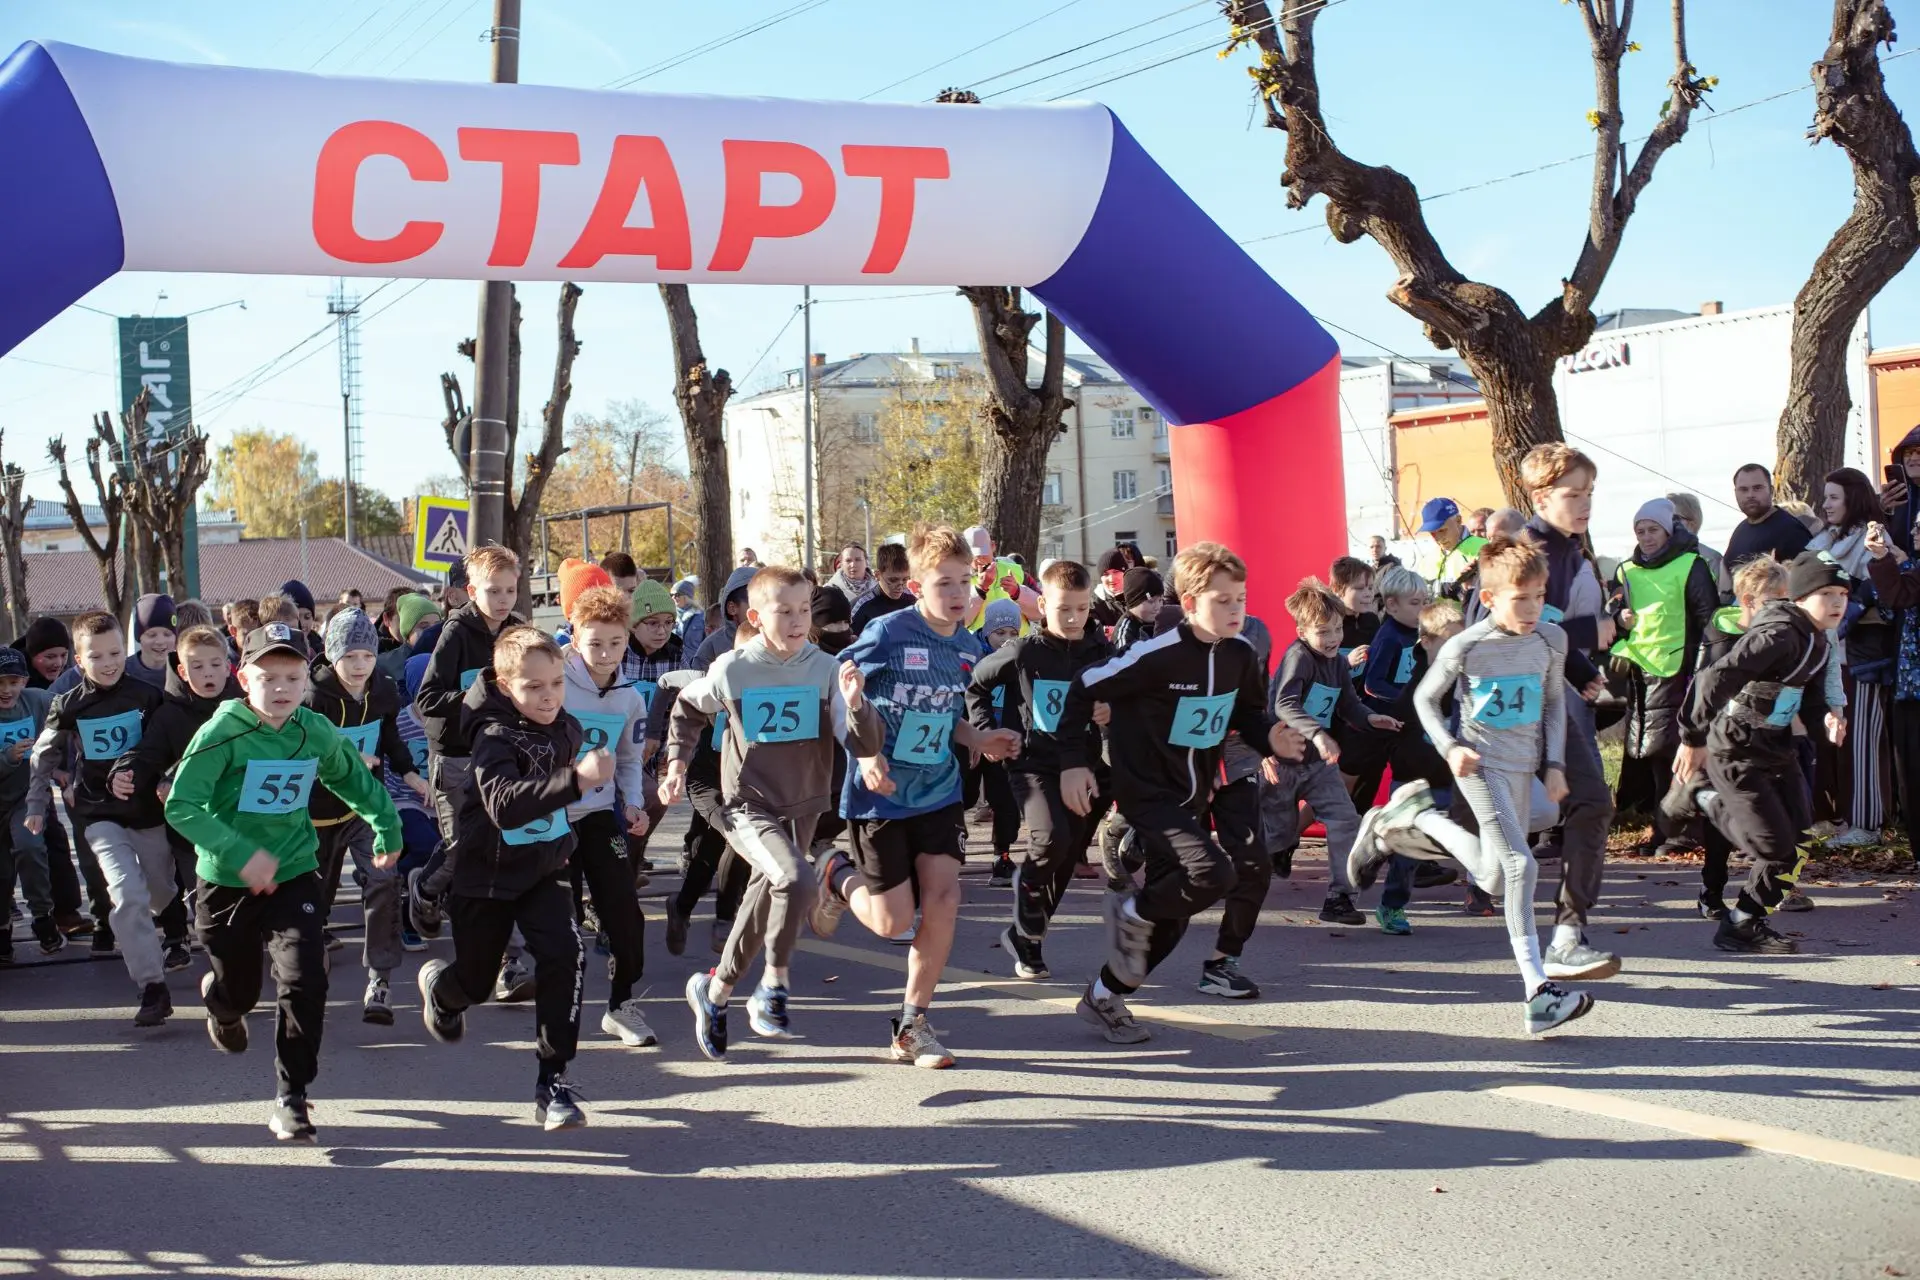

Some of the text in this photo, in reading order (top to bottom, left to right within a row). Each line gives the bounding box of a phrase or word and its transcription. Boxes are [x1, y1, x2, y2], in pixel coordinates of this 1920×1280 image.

[312, 119, 951, 274] СТАРТ
[1168, 683, 1199, 691] KELME
[1486, 686, 1525, 717] 34
[757, 701, 801, 733] 25
[1187, 703, 1230, 736] 26
[93, 725, 128, 753] 59
[910, 724, 945, 754] 24
[256, 773, 305, 805] 55
